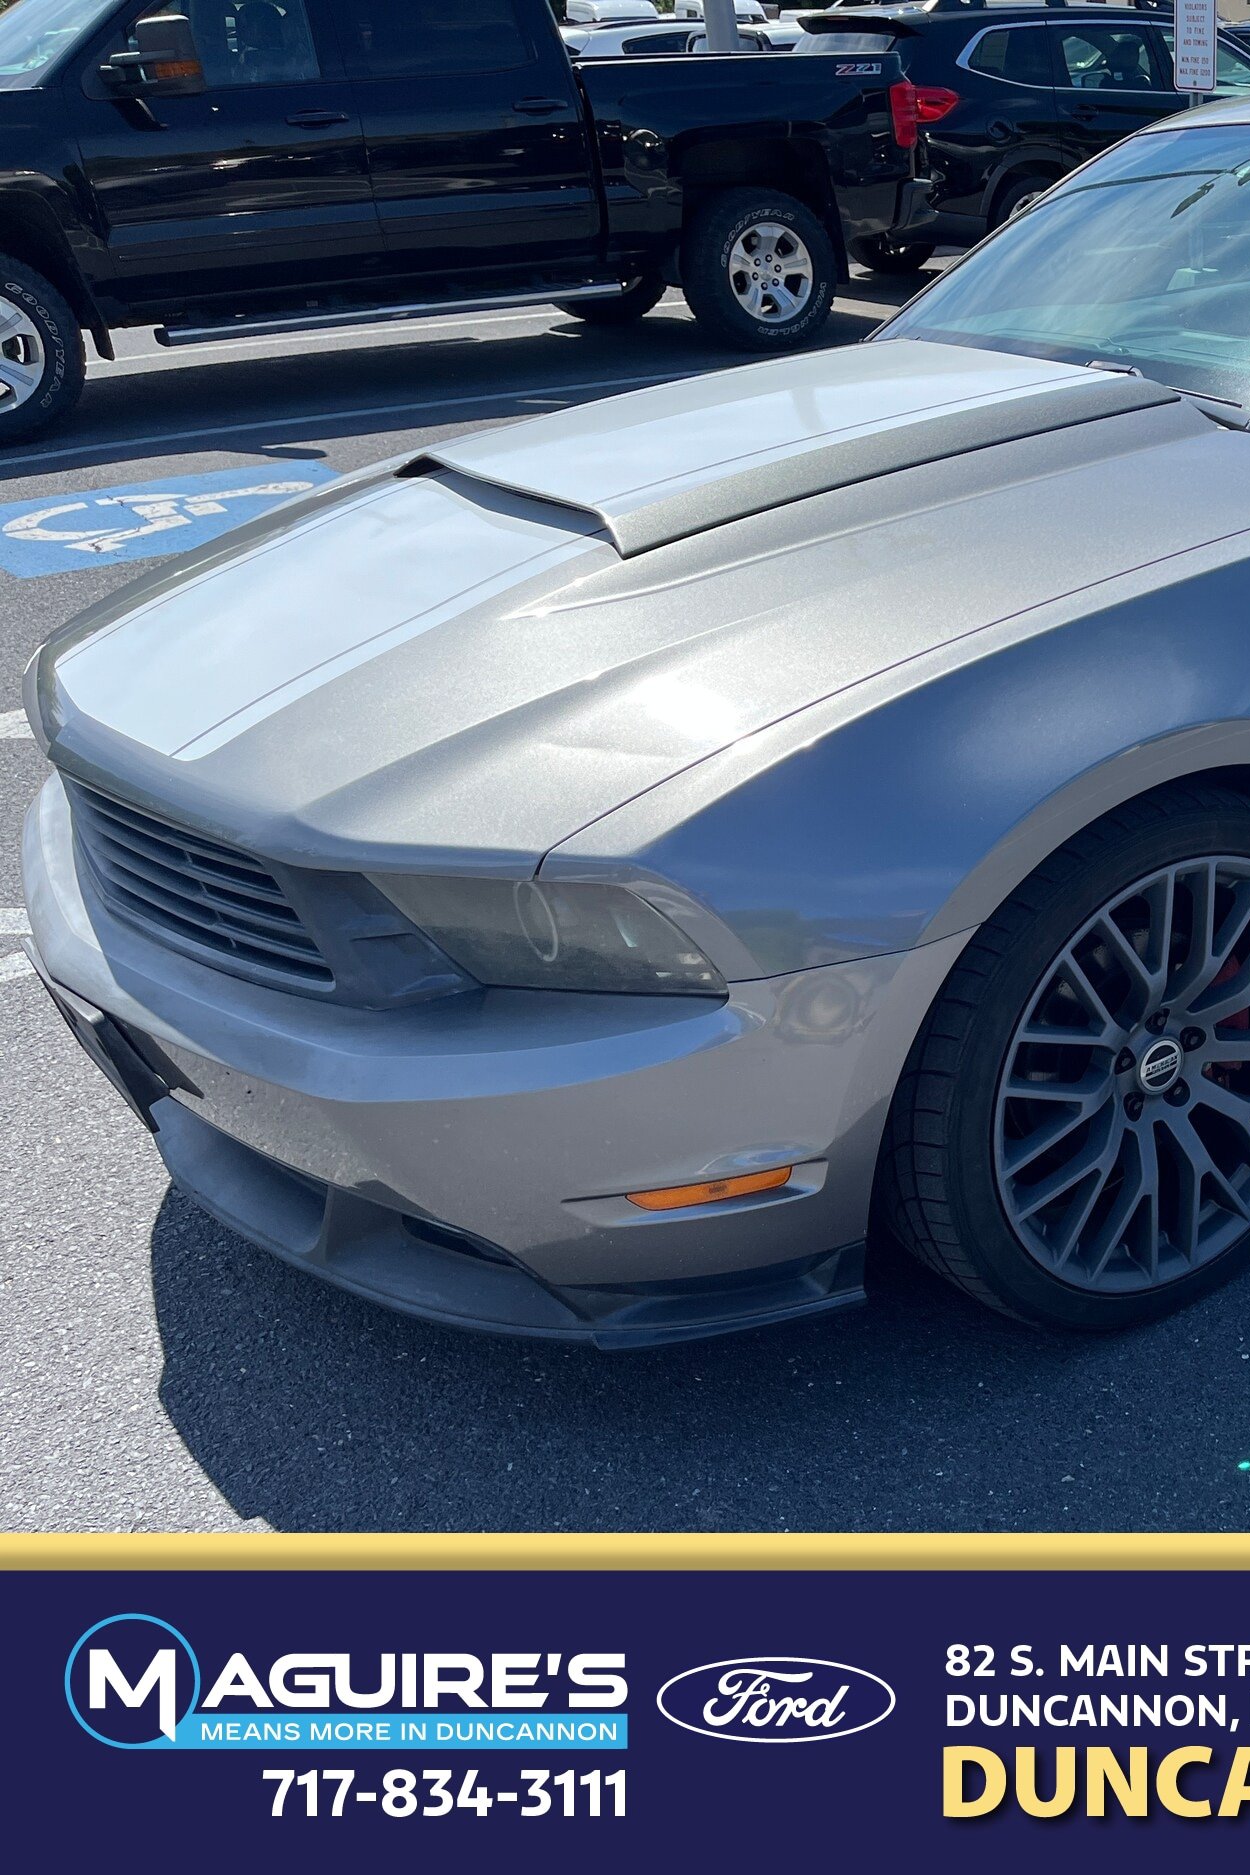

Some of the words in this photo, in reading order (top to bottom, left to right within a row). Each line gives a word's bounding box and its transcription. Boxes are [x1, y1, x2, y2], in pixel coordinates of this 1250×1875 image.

[1184, 3, 1208, 11] VIOLATORS
[1186, 15, 1205, 23] SUBJECT
[1186, 27, 1192, 35] TO
[1194, 27, 1205, 35] FINE
[1192, 39, 1208, 47] TOWING
[1181, 56, 1190, 64] MIN
[1190, 56, 1200, 65] FINE
[835, 63, 882, 76] Z71
[1189, 68, 1199, 76] FINE
[719, 208, 796, 269] GOODYEAR
[757, 281, 827, 337] WRANGLER
[4, 282, 66, 408] GOODYEAR
